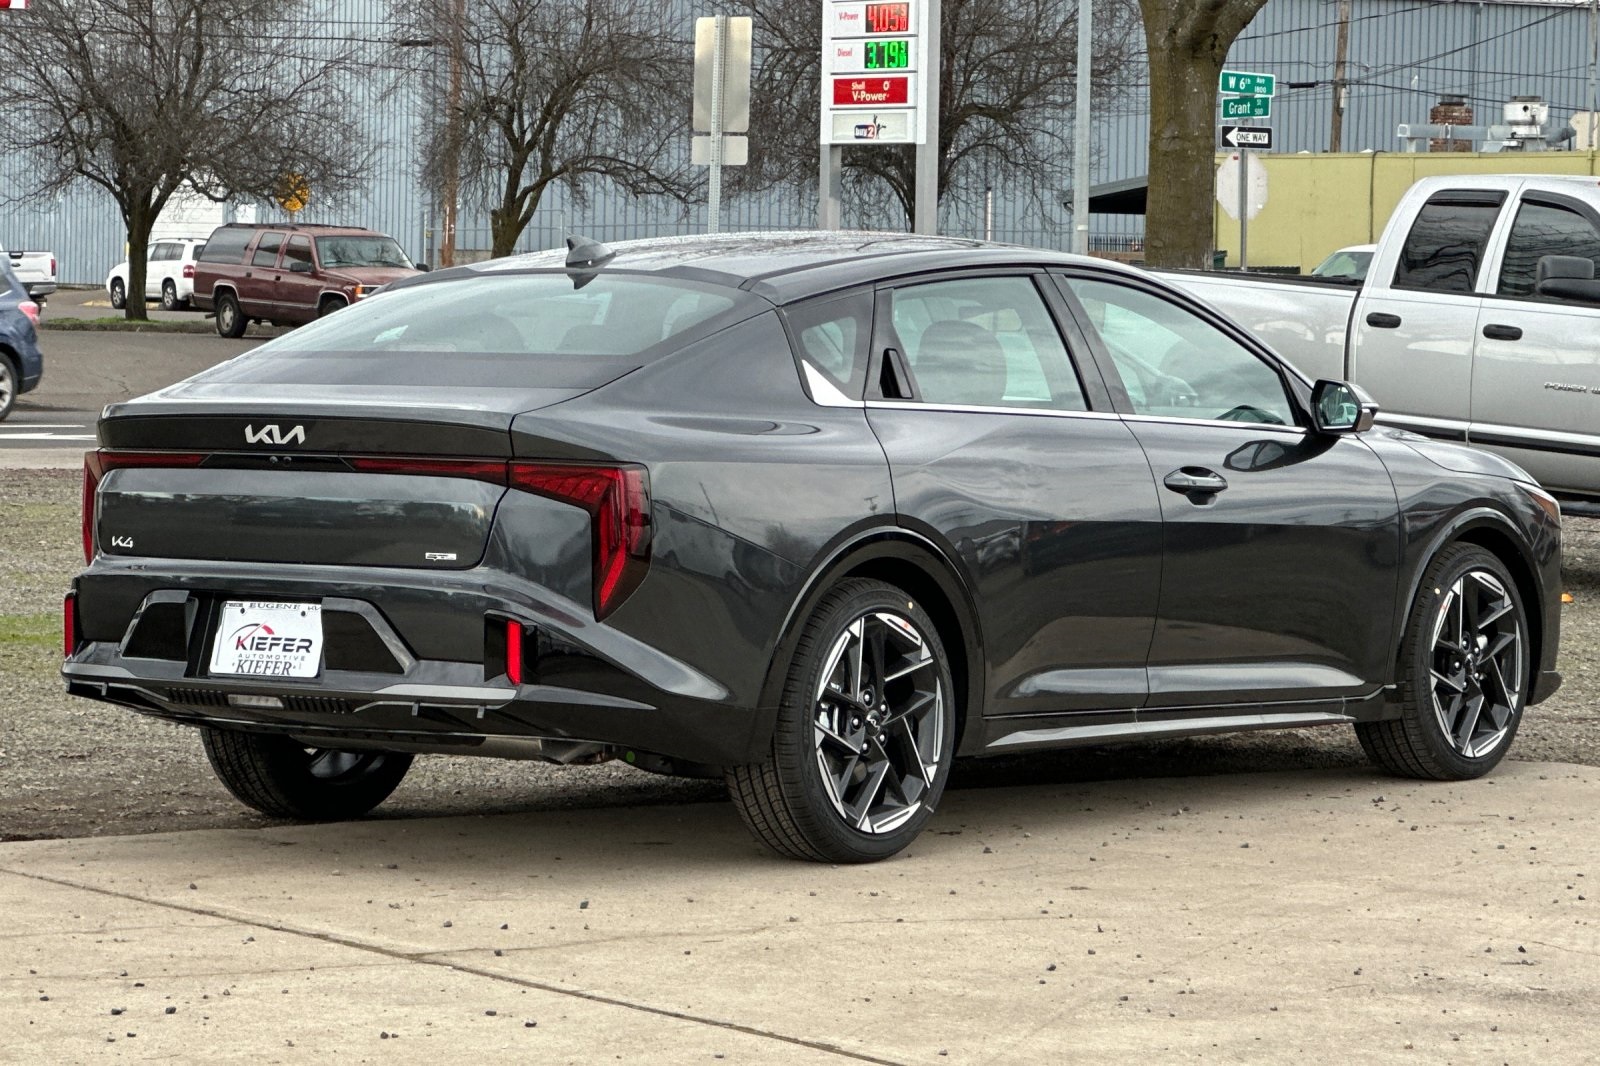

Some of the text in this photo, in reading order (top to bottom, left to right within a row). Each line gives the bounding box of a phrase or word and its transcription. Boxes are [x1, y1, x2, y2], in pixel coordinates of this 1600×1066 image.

[837, 48, 852, 57] Diesel
[851, 81, 866, 90] Shell
[1228, 76, 1237, 89] W
[852, 90, 887, 101] V-Power
[1228, 101, 1251, 115] Grant
[1236, 133, 1267, 142] ONE WAY
[111, 535, 134, 549] K4
[249, 602, 301, 610] EUGENE
[235, 636, 313, 653] KIEFER
[238, 653, 305, 661] AUTOMOTIVE
[235, 659, 292, 675] KIEFER
